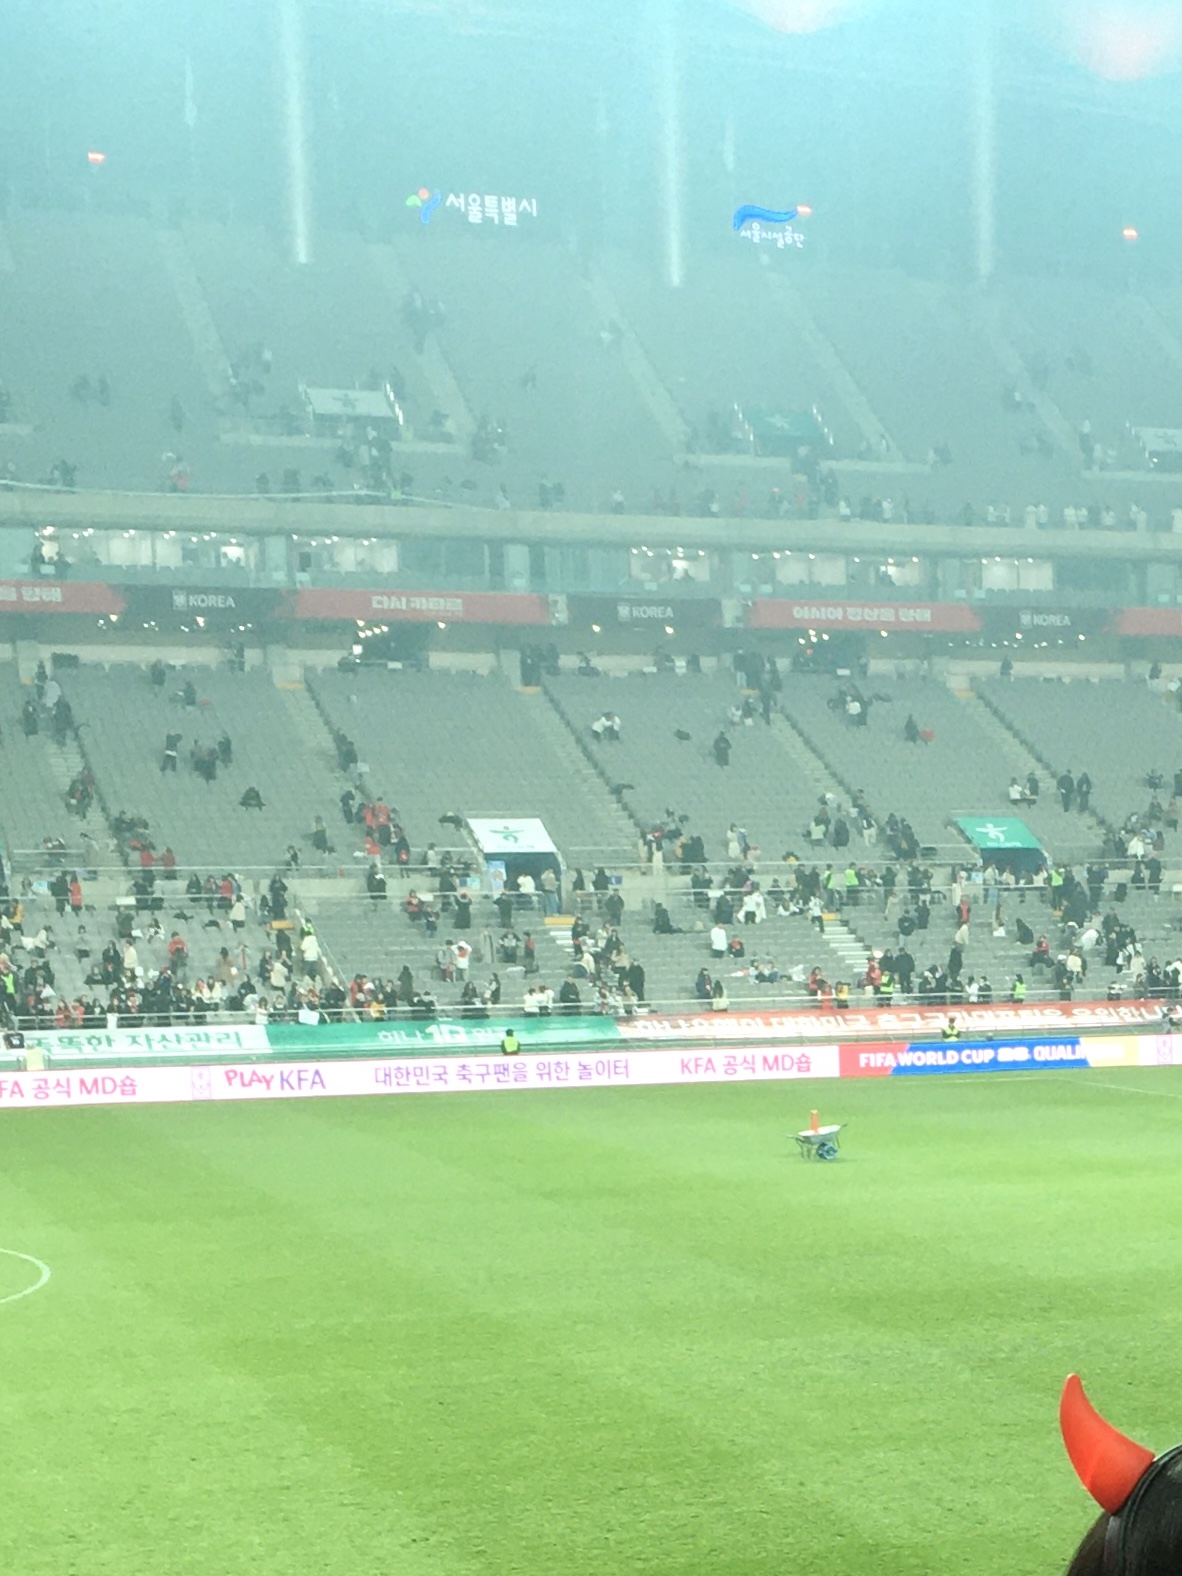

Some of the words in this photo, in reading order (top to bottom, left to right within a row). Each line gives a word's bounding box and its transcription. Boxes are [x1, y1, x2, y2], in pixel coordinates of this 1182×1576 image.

[445, 193, 537, 226] 서울특별시
[740, 222, 804, 249] 서울시설공단
[188, 595, 236, 608] KOREA
[632, 606, 674, 619] KOREA
[1033, 614, 1071, 627] KOREA
[126, 1031, 242, 1050] 자산관리
[681, 1057, 716, 1074] KFA
[723, 1055, 756, 1075] 공식
[762, 1053, 811, 1072] MD숍
[859, 1053, 896, 1067] FIFA
[897, 1050, 959, 1066] WORLD
[961, 1049, 995, 1064] CUP
[280, 1069, 326, 1090] KFA
[375, 1065, 448, 1086] 대한민국
[456, 1063, 527, 1084] 축구팬을
[536, 1061, 569, 1081] 위한
[578, 1059, 629, 1080] 놀이터
[33, 1077, 71, 1100] 공식
[79, 1076, 137, 1096] MD숍
